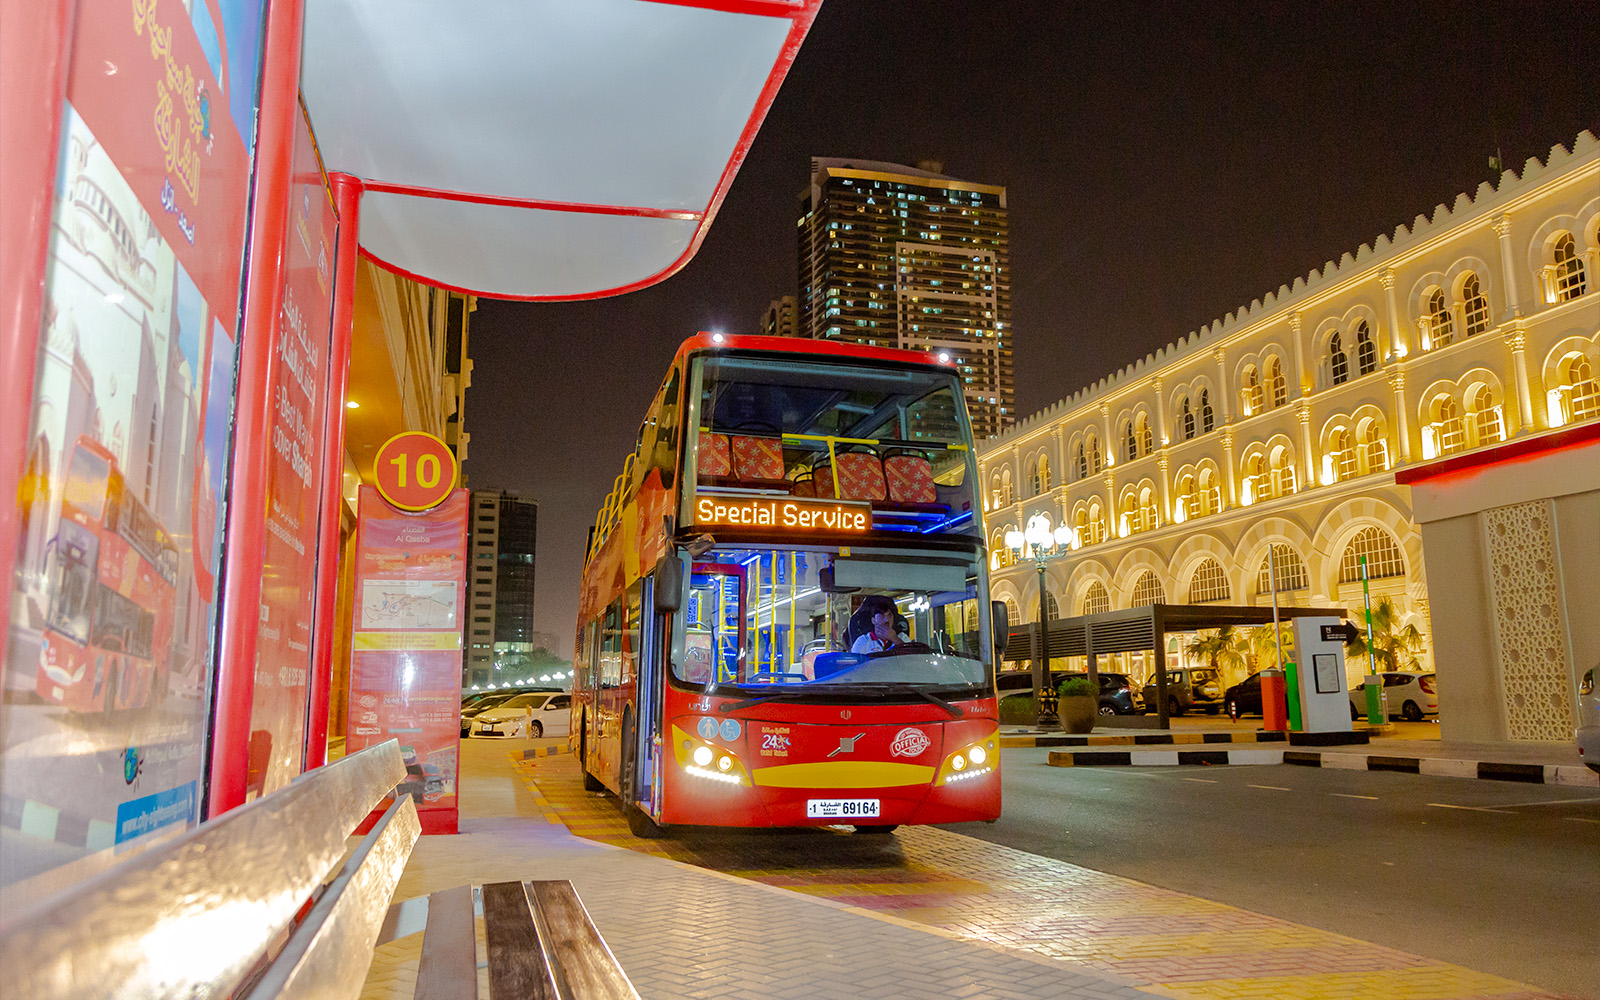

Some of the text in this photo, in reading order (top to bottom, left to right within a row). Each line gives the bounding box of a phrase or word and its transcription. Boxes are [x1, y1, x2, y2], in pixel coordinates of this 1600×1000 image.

[154, 80, 200, 206] الشارقة
[280, 385, 296, 432] Best
[390, 453, 441, 488] 10
[698, 499, 866, 530] Special Service
[405, 535, 430, 543] Qasba
[762, 734, 778, 749] 24
[894, 737, 928, 752] OFFICIAL
[812, 803, 817, 813] 1
[843, 802, 876, 814] 69164
